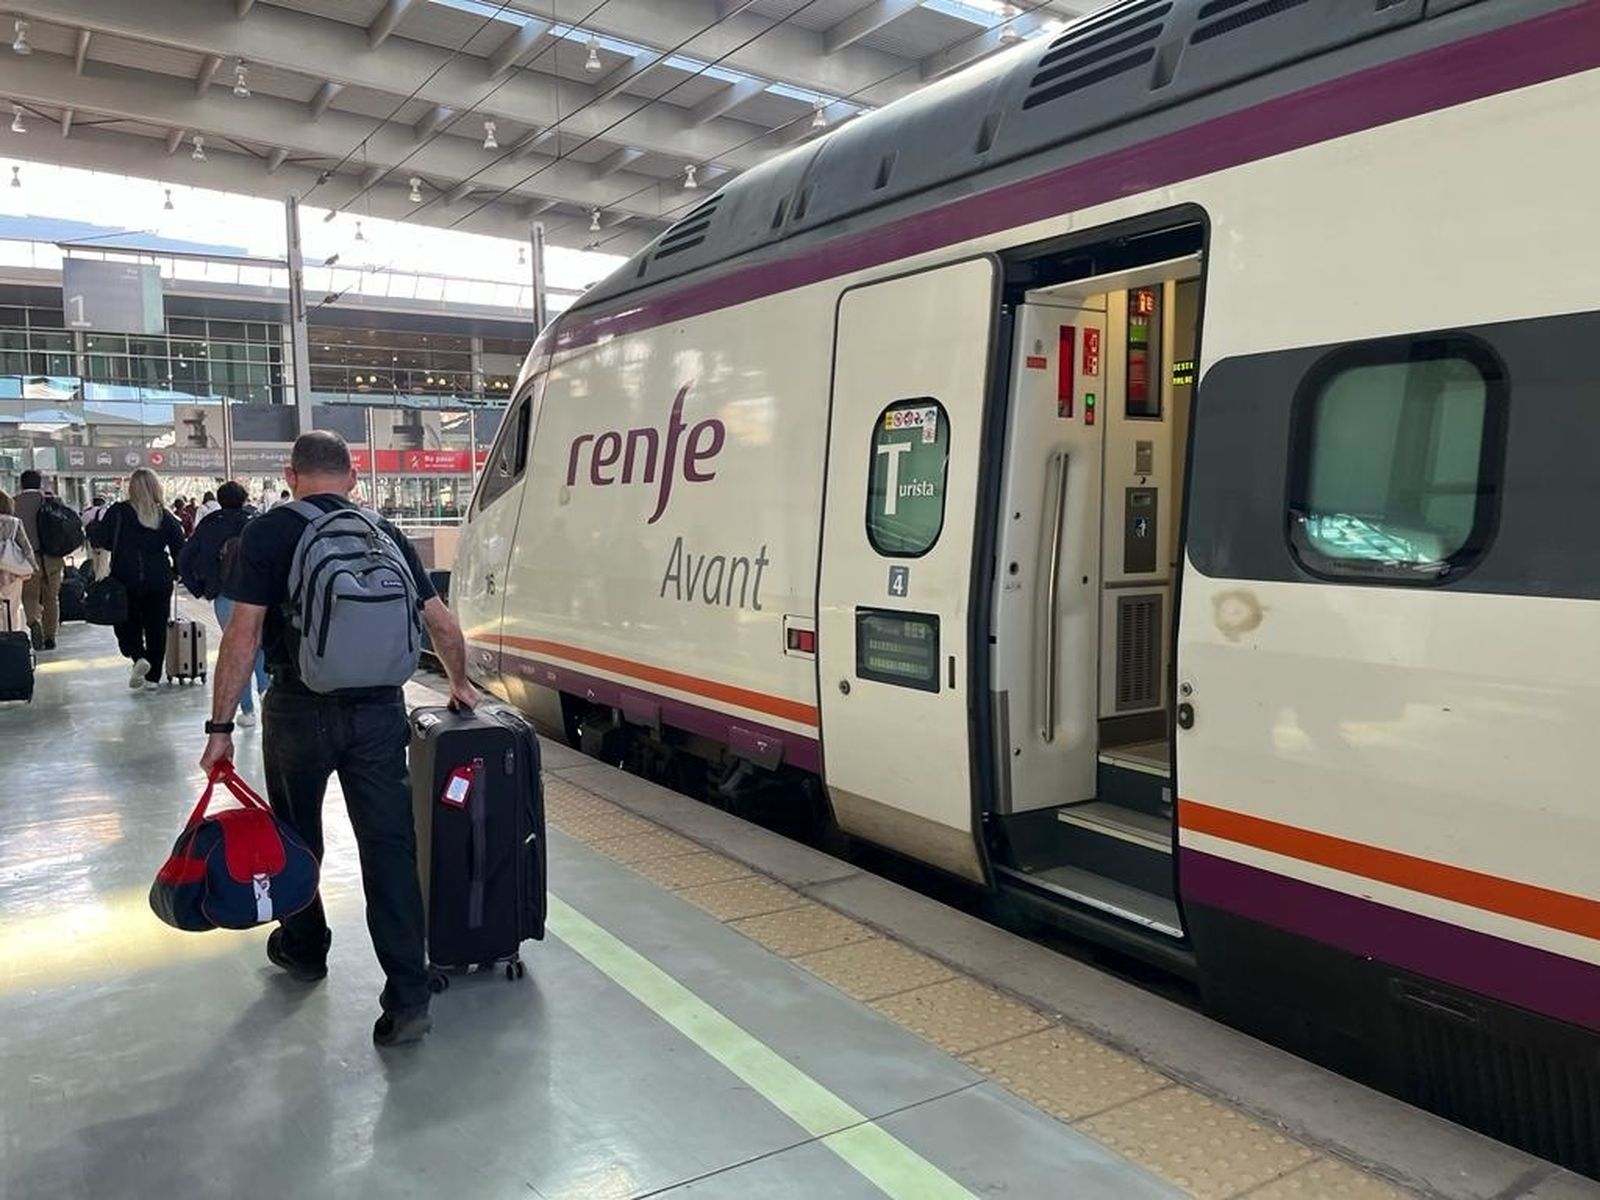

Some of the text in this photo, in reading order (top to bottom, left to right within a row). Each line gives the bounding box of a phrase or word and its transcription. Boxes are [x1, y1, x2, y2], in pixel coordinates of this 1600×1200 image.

[69, 294, 92, 328] 1
[566, 378, 726, 524] renfe
[660, 536, 769, 611] Avant
[892, 574, 904, 595] 4
